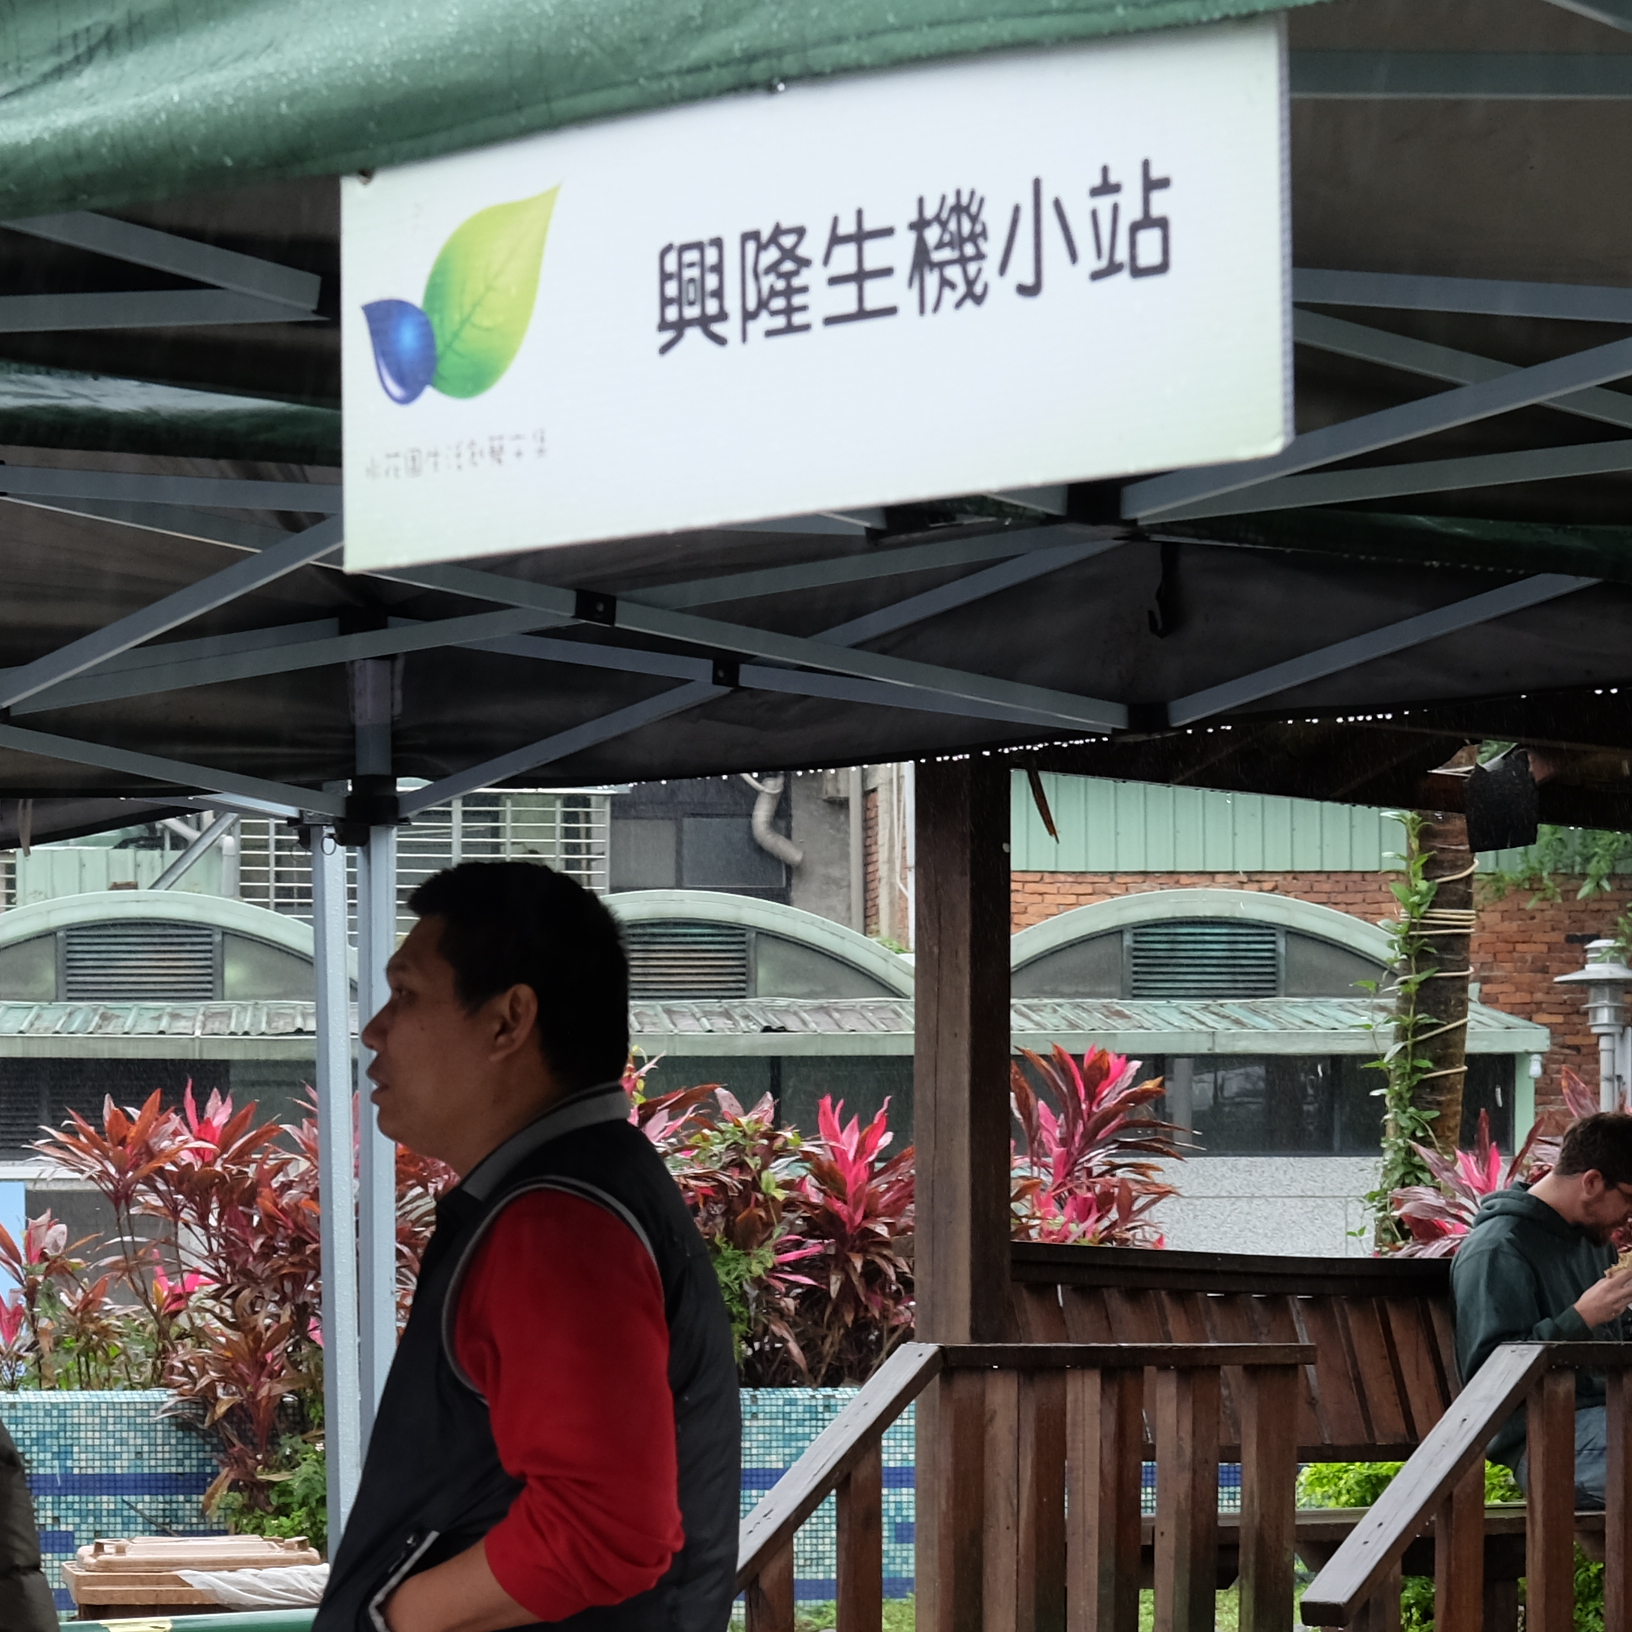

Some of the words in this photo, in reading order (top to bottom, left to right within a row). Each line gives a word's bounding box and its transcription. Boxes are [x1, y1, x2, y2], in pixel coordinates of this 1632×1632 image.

[655, 158, 1173, 356] 興隆生機小站
